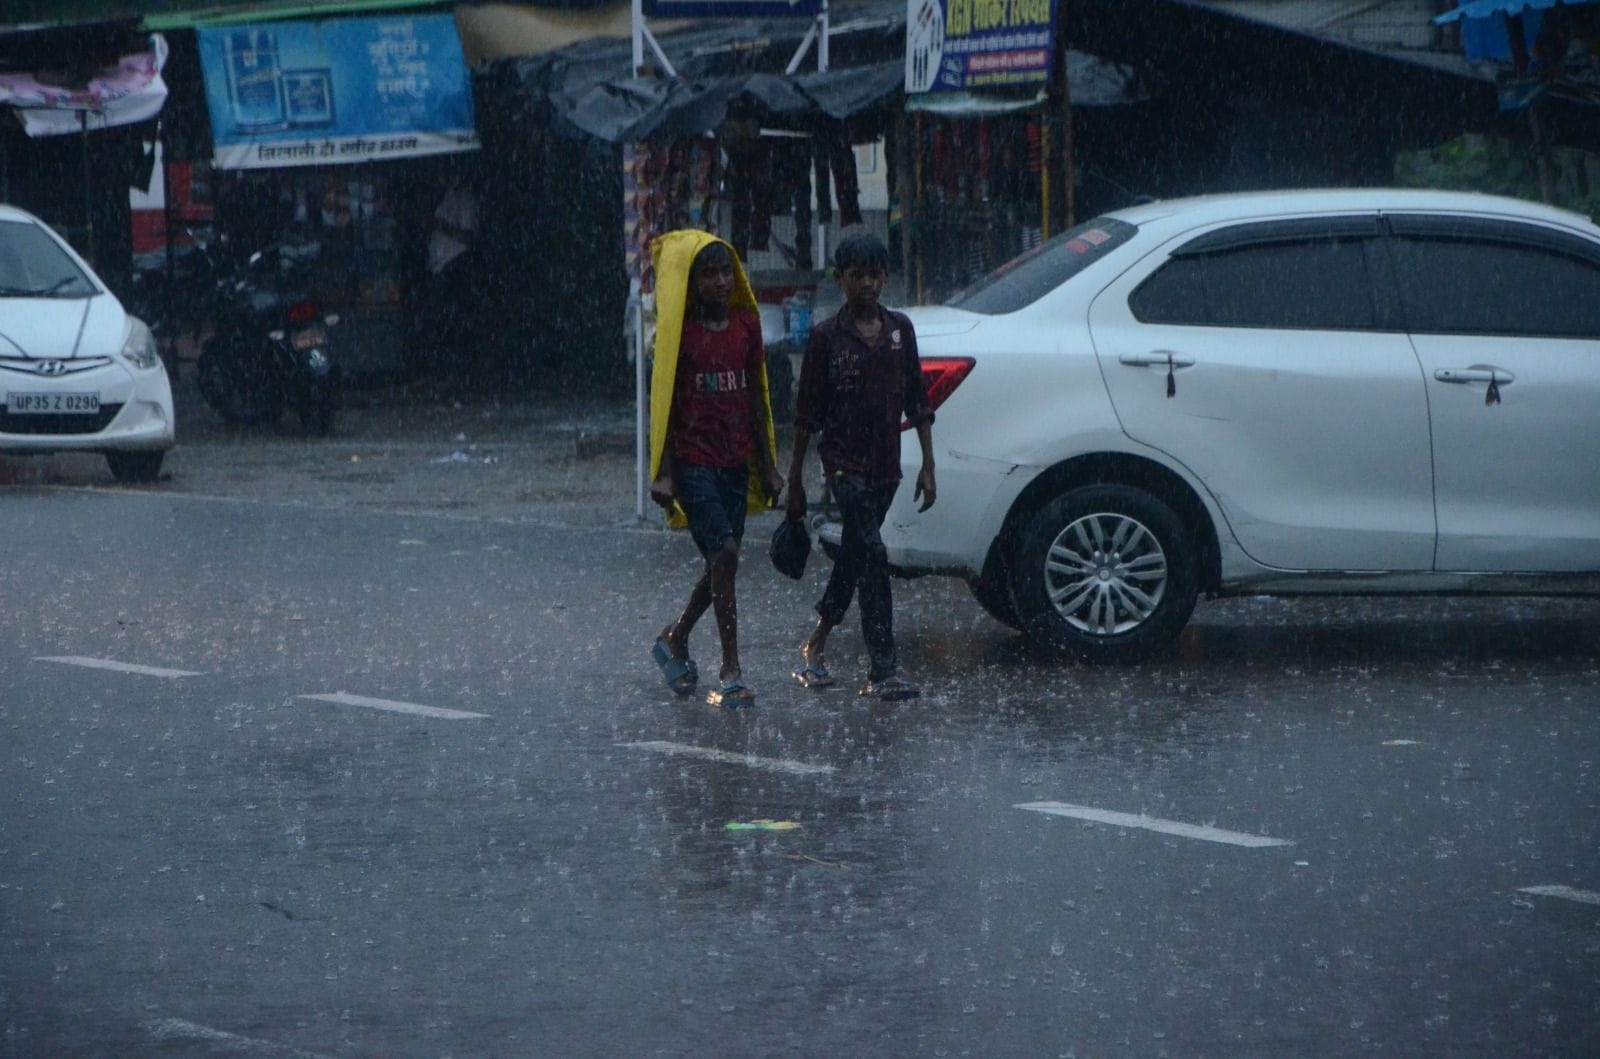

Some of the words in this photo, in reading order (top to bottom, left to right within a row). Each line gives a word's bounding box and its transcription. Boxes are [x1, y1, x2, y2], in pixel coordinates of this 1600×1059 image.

[16, 396, 49, 410] UP35
[54, 396, 62, 409] Z
[66, 396, 98, 409] 0290
